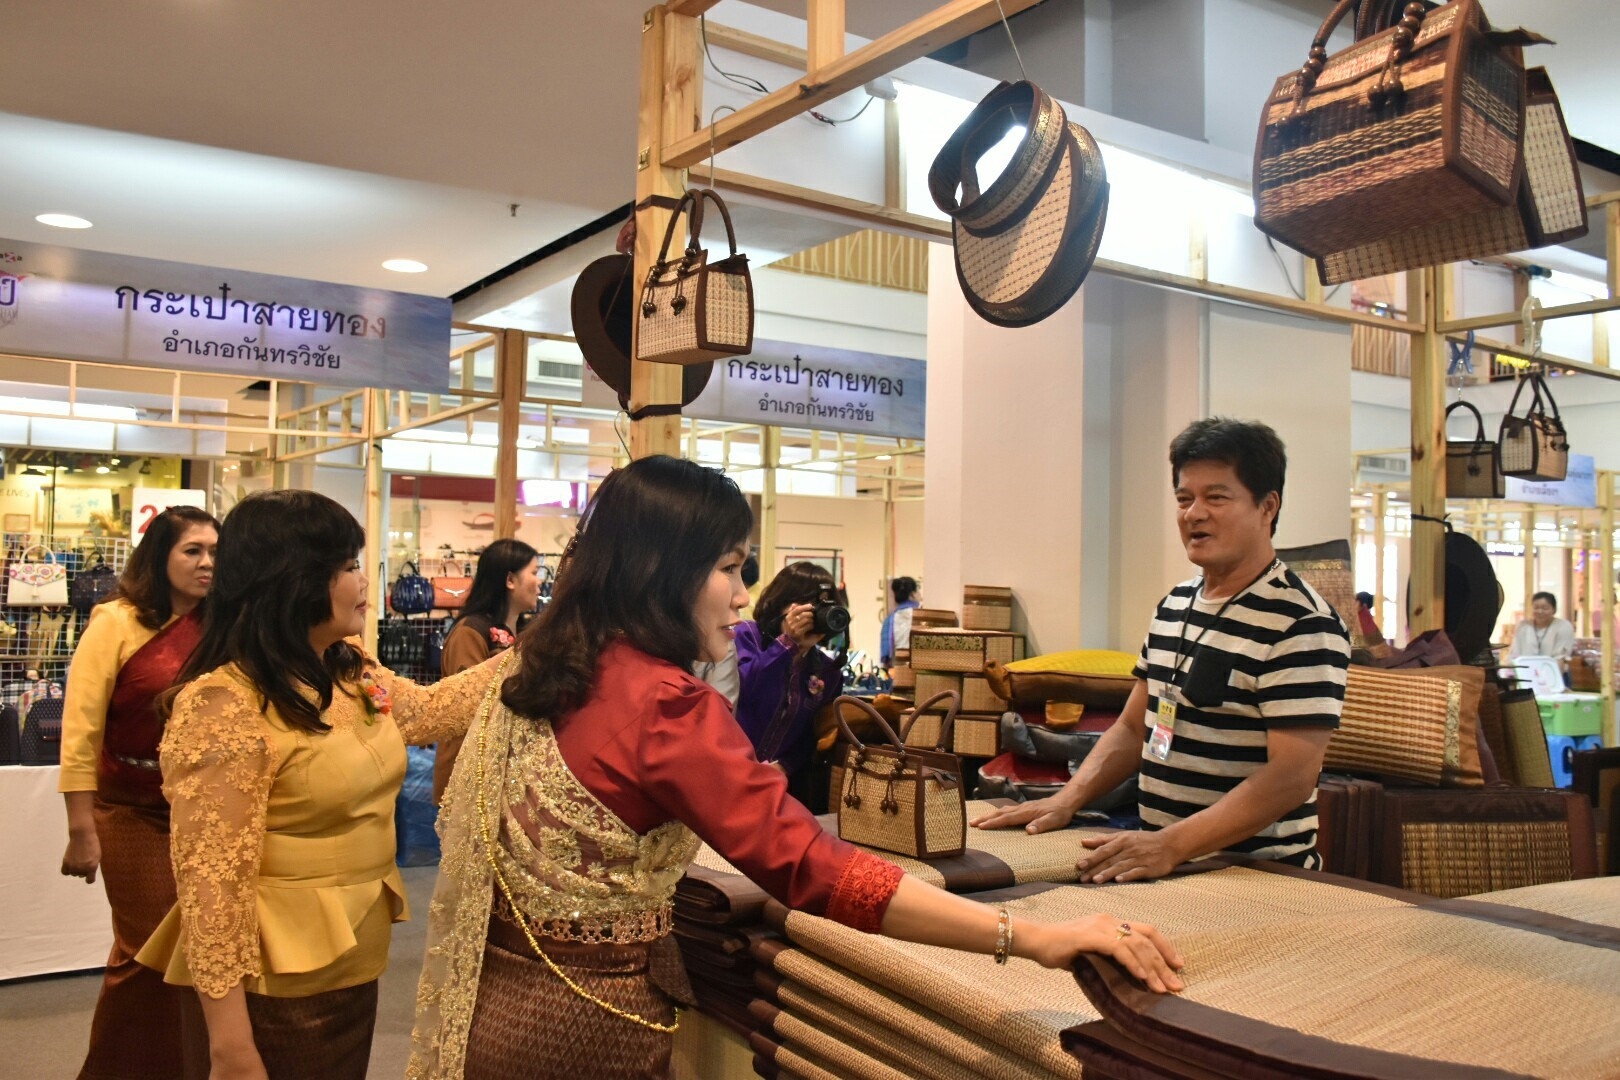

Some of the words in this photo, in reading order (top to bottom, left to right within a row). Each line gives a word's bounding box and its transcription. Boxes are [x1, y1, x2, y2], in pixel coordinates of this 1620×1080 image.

[114, 282, 386, 340] กระเป๋าสายทอง
[162, 329, 342, 369] อำเภอกันทรวิชัย
[727, 354, 904, 397] กระเป๋าสายทอง
[758, 392, 875, 422] อำเภอกันทรวิชัย
